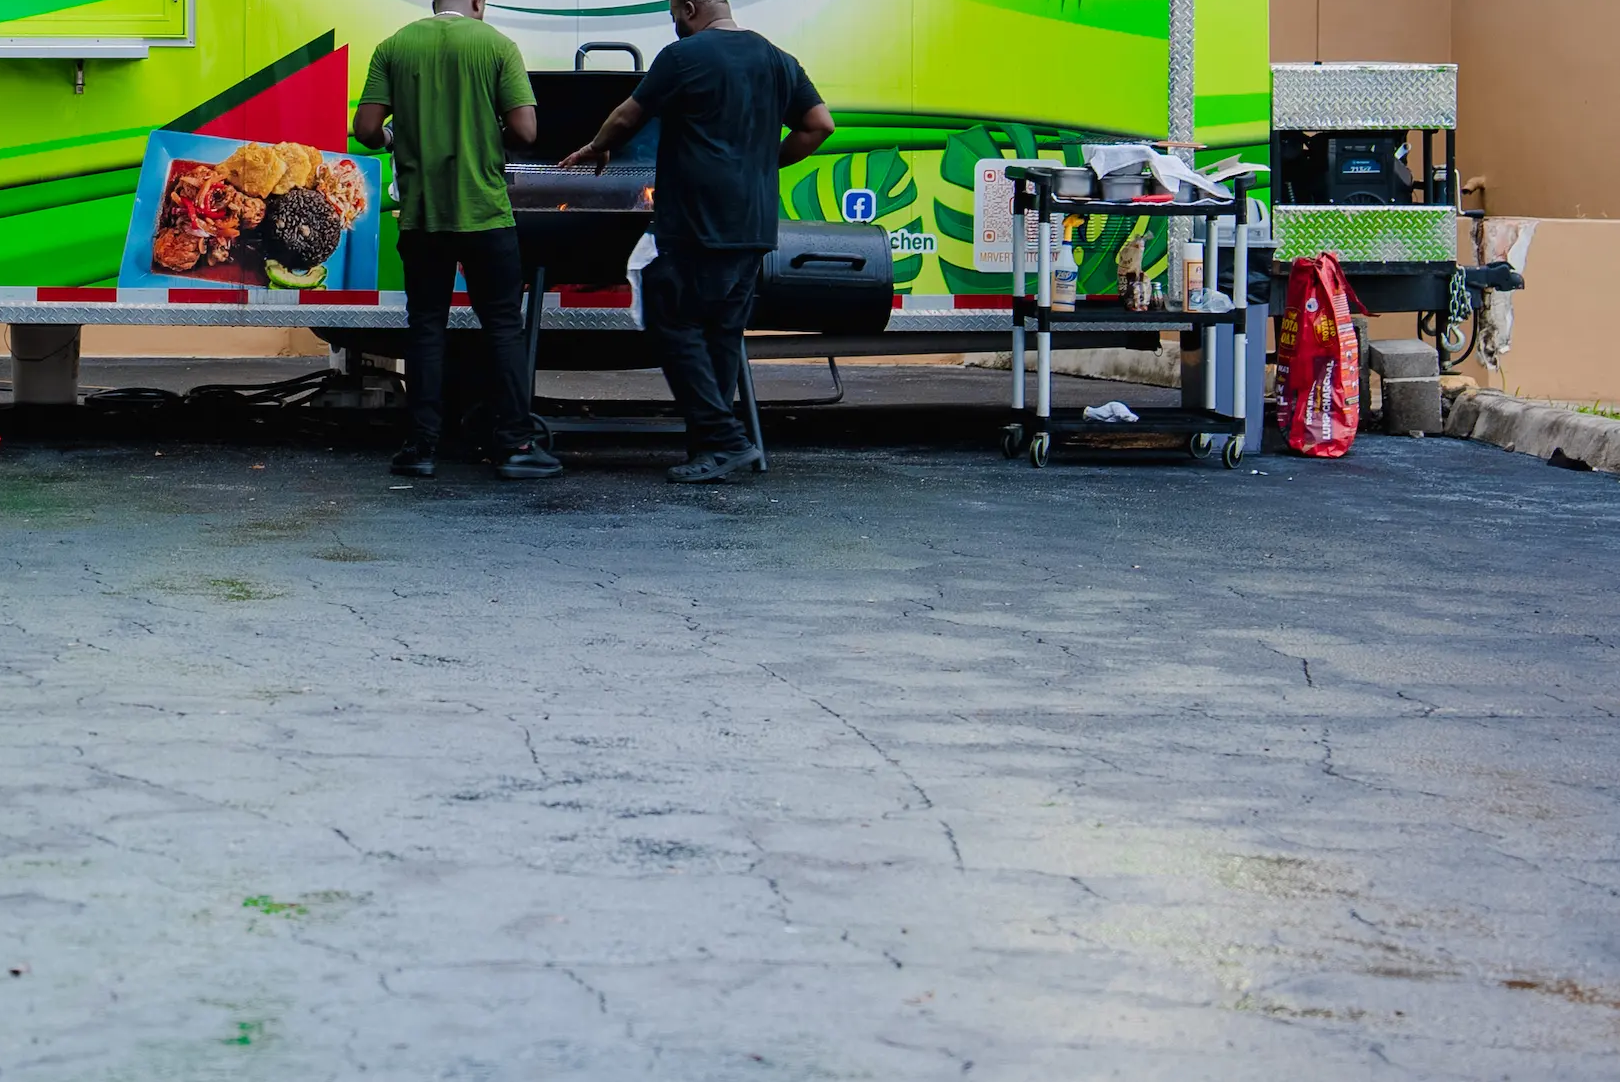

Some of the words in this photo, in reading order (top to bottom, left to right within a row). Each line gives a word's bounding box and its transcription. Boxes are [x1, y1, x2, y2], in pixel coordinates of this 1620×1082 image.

[890, 232, 934, 250] chen
[1322, 360, 1335, 412] CHARCOAL
[1322, 413, 1331, 440] LUMP
